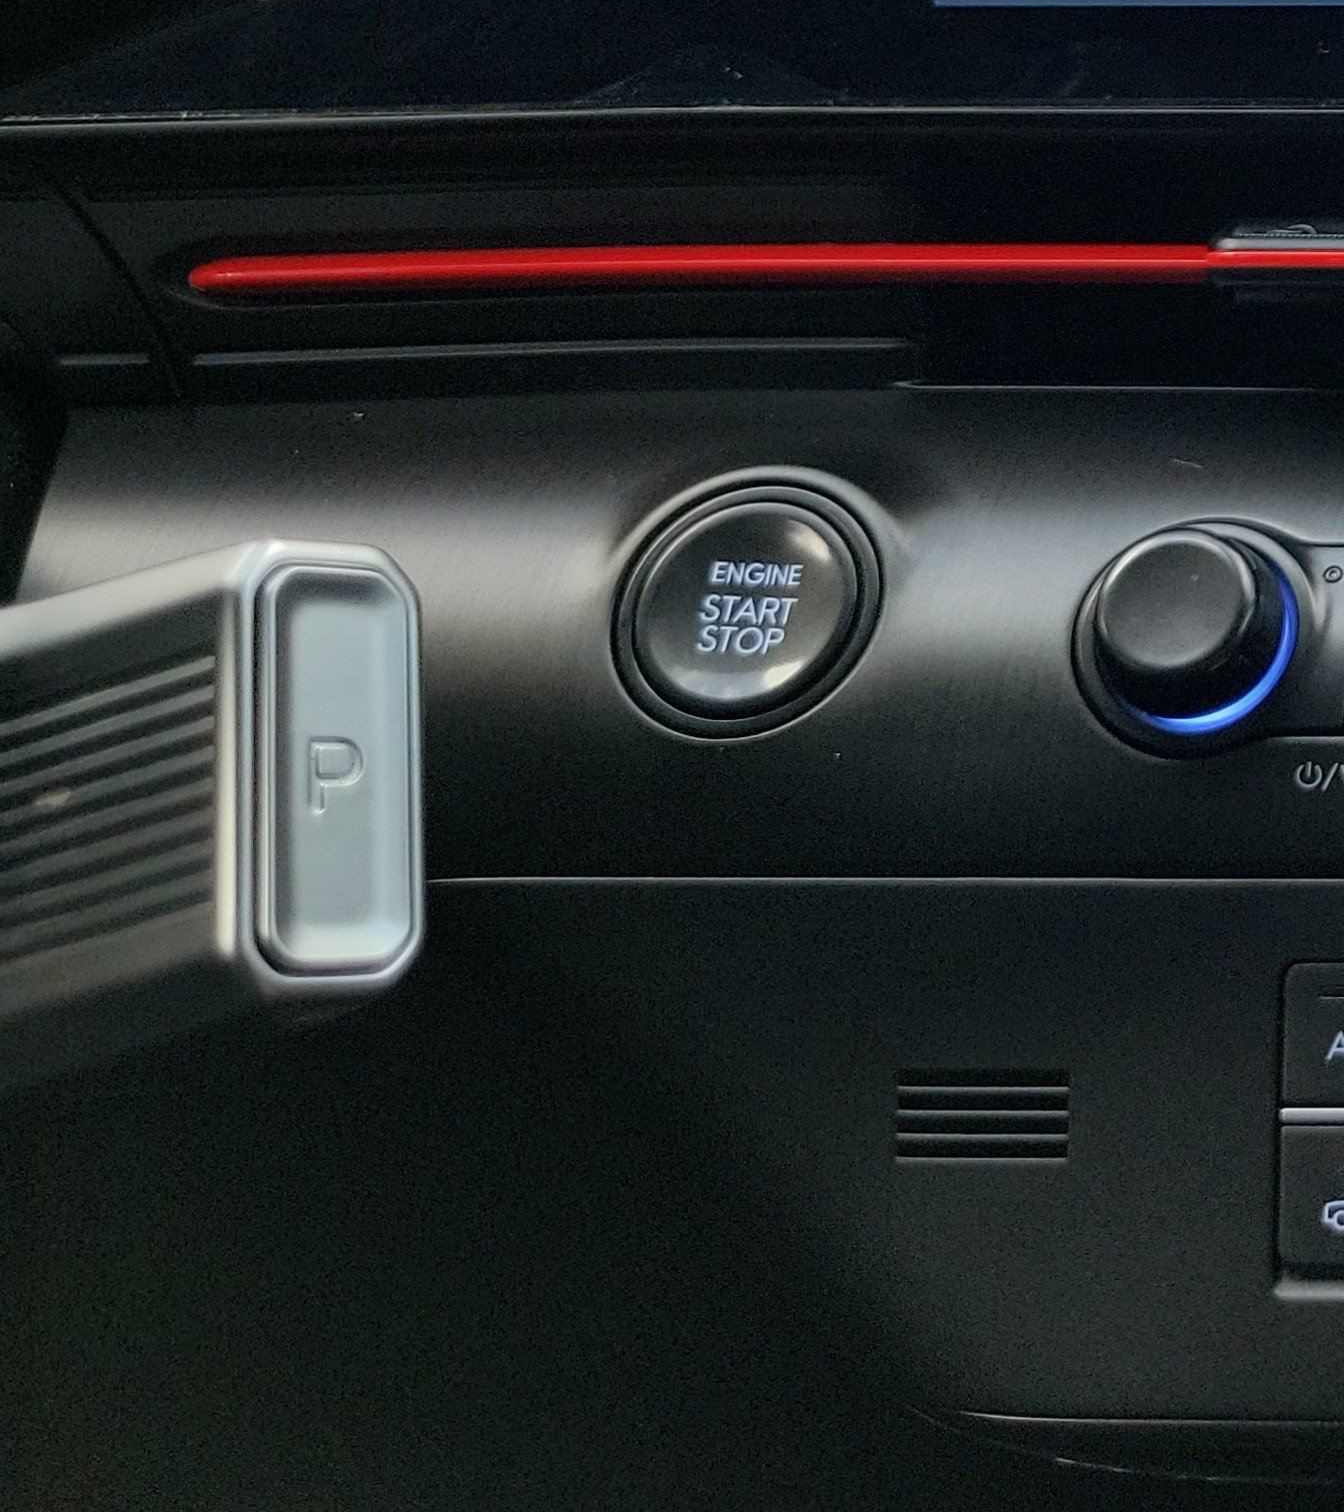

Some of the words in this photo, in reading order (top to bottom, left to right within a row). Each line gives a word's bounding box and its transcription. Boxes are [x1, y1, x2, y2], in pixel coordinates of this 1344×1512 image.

[711, 561, 803, 587] ENGINE
[700, 594, 799, 624] START
[697, 625, 785, 655] STOP
[307, 736, 365, 815] P
